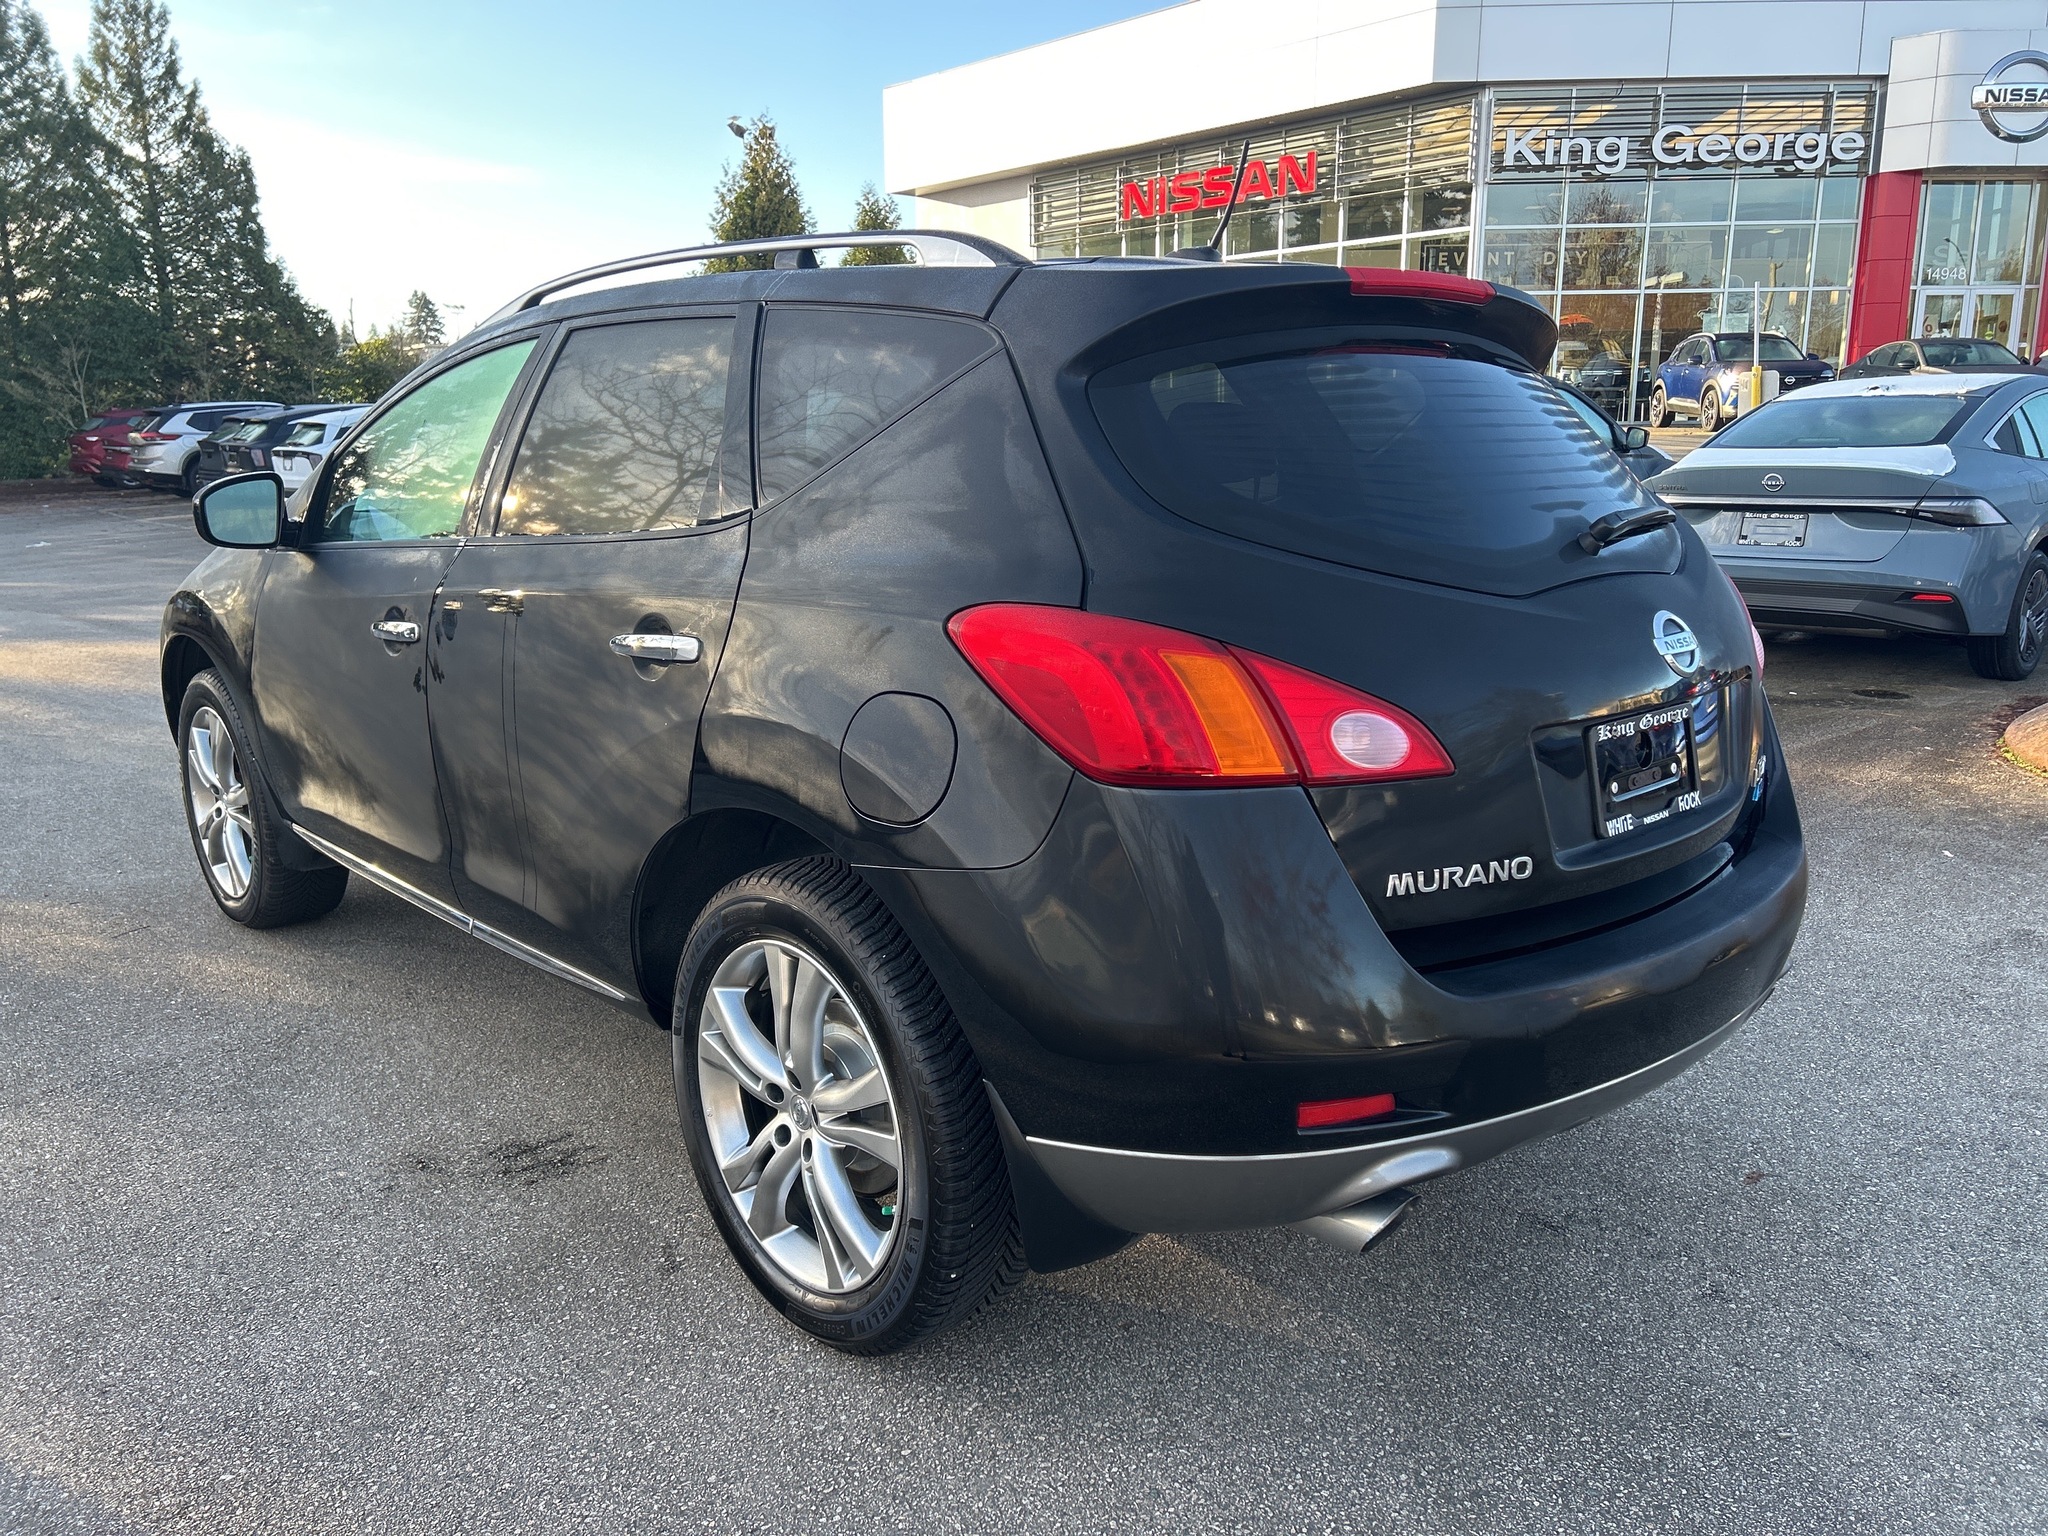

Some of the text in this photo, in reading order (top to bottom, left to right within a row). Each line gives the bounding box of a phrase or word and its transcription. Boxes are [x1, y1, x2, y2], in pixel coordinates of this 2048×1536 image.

[1504, 124, 1865, 174] King George
[1122, 150, 1317, 220] NISSAN
[1438, 251, 1515, 266] EVNT
[1926, 267, 1967, 280] 14948
[1597, 707, 1689, 741] King George
[1606, 791, 1701, 837] WHITE NISSAN ROCK
[1386, 856, 1533, 897] MURANO
[856, 1258, 913, 1334] MICHELIN
